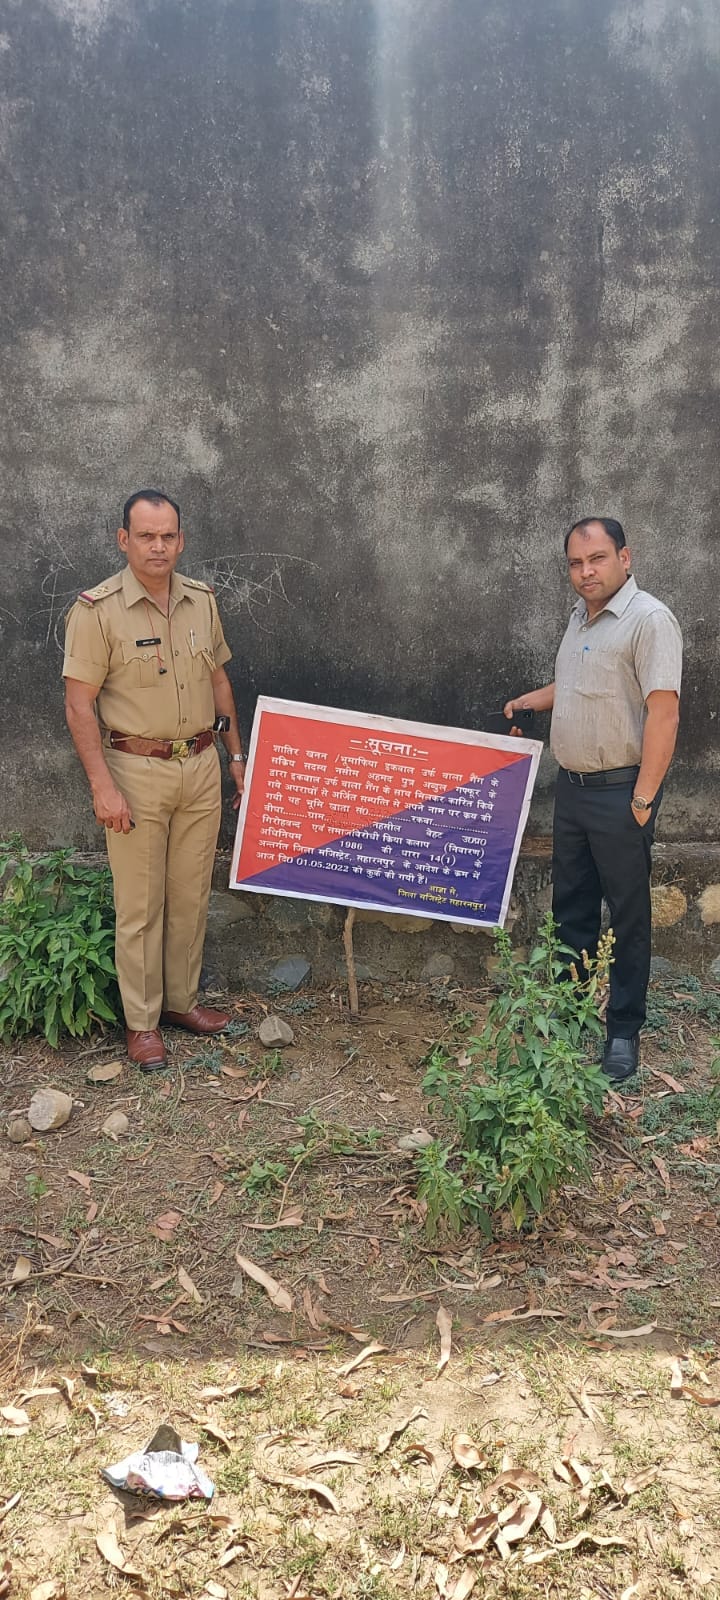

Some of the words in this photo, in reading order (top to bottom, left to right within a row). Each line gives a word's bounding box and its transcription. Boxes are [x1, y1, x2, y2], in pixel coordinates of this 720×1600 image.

[273, 744, 299, 756] शातिर
[306, 750, 328, 760] खनन
[422, 768, 436, 778] उर्फ
[470, 773, 484, 785] गैंग
[490, 778, 500, 788] के
[304, 762, 327, 772] सदस्य
[368, 772, 393, 783] अहमद
[402, 778, 415, 788] पुत्र
[488, 791, 496, 800] के
[269, 768, 287, 778] द्वारा
[324, 776, 338, 786] उर्फ
[366, 781, 380, 792] गैंग
[382, 786, 390, 794] के
[394, 788, 411, 798] साथ
[414, 790, 445, 802] मिलकर
[448, 796, 472, 808] कारित
[288, 796, 301, 805] यह
[321, 788, 329, 797] से
[393, 798, 401, 808] से
[404, 801, 425, 812] अपने
[428, 806, 445, 815] नाम
[448, 808, 461, 817] पर
[480, 812, 492, 822] की
[312, 823, 326, 833] एवं
[406, 838, 430, 848] कलाप
[372, 820, 402, 832] तहसील
[261, 826, 302, 840] अधिनियम
[340, 840, 362, 850] 1986
[381, 846, 392, 855] की
[430, 854, 456, 866] 14(1)
[474, 860, 482, 868] के
[293, 842, 315, 854] जिला
[356, 854, 396, 868] सहारनपुर
[402, 860, 411, 869] के
[414, 862, 439, 874] आदेश
[442, 866, 450, 876] के
[472, 870, 481, 880] में
[256, 852, 276, 860] आज
[296, 858, 350, 873] 01.05.2022
[352, 866, 363, 874] को
[384, 870, 395, 880] की
[398, 888, 416, 899] जिला
